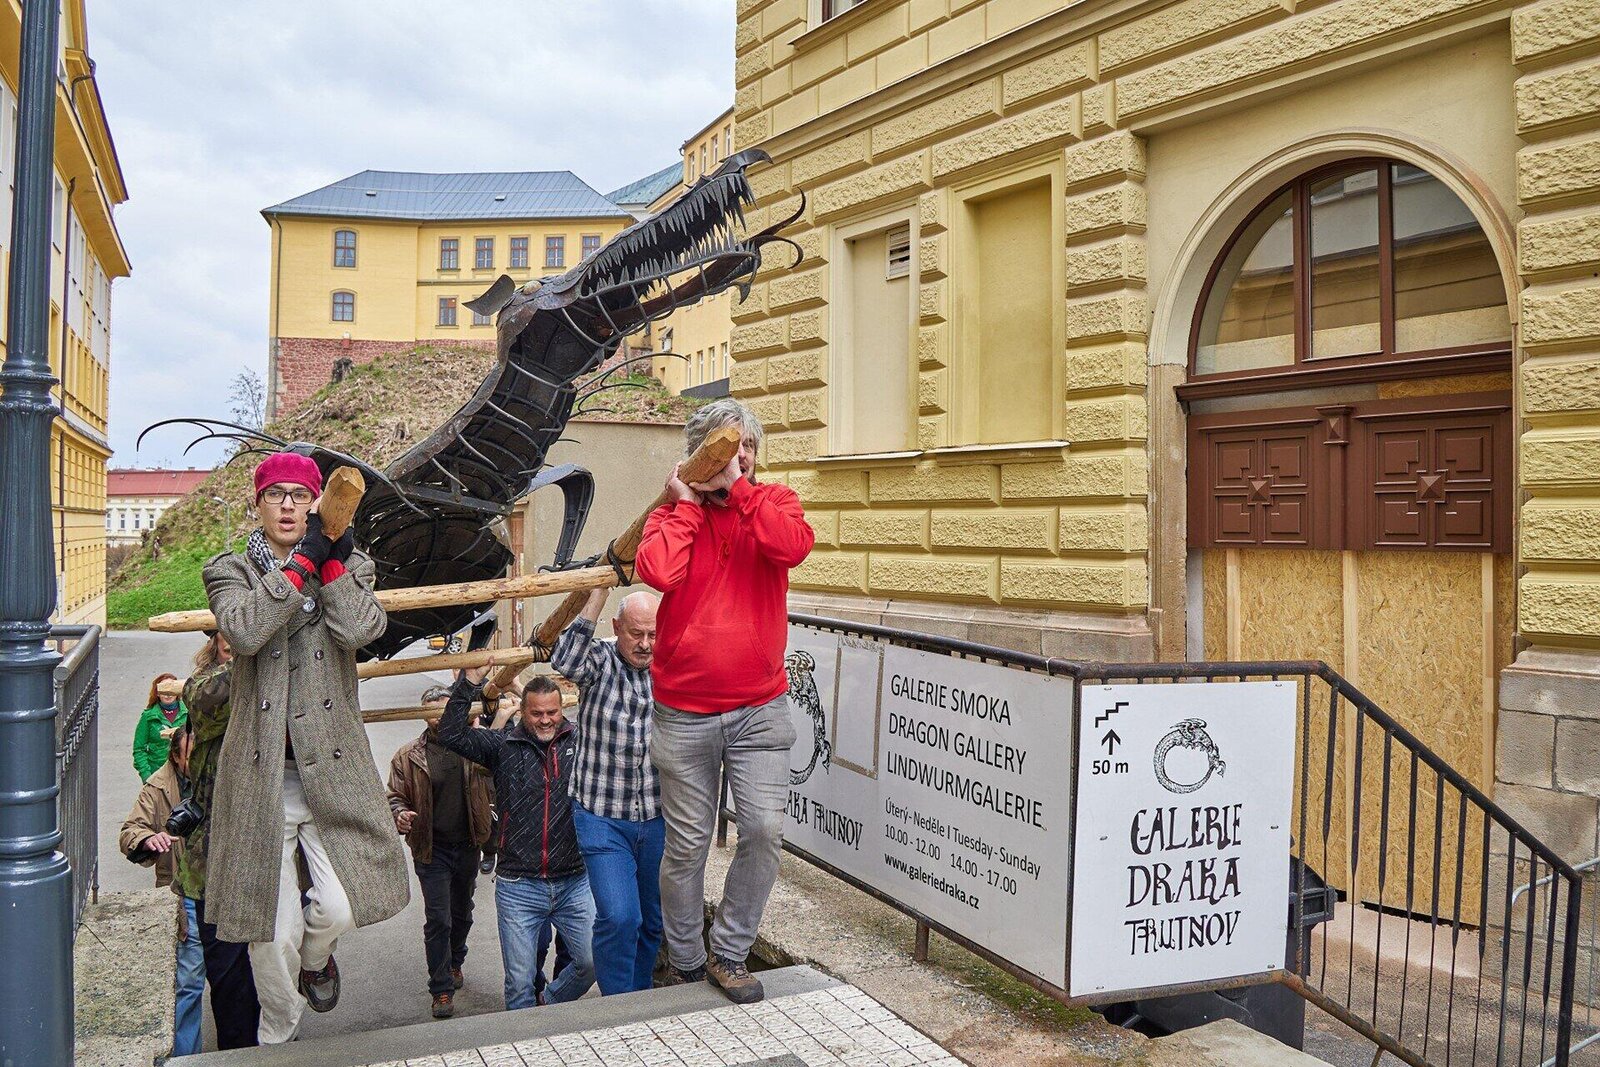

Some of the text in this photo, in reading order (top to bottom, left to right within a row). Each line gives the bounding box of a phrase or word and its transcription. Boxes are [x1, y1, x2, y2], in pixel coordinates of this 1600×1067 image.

[891, 674, 1011, 726] GALERIE SMOKA
[889, 712, 1027, 775] DRAGON GALLERY
[1092, 760, 1129, 775] 50 m
[887, 751, 1043, 828] LINDWURMGALERIE
[784, 790, 863, 851] AKA TRUTNOV
[913, 811, 945, 837] Neděle
[952, 827, 993, 861] Tuesday
[999, 846, 1041, 880] Sunday
[1130, 803, 1243, 855] GALERIE
[884, 852, 980, 910] www.galeriedraka.cz
[885, 824, 908, 846] 10.00
[916, 837, 941, 861] 12.00
[950, 853, 978, 878] 14.00
[987, 869, 1017, 895] 17.00
[1125, 857, 1241, 908] DRAKA
[1124, 910, 1242, 955] TRUTNOV
